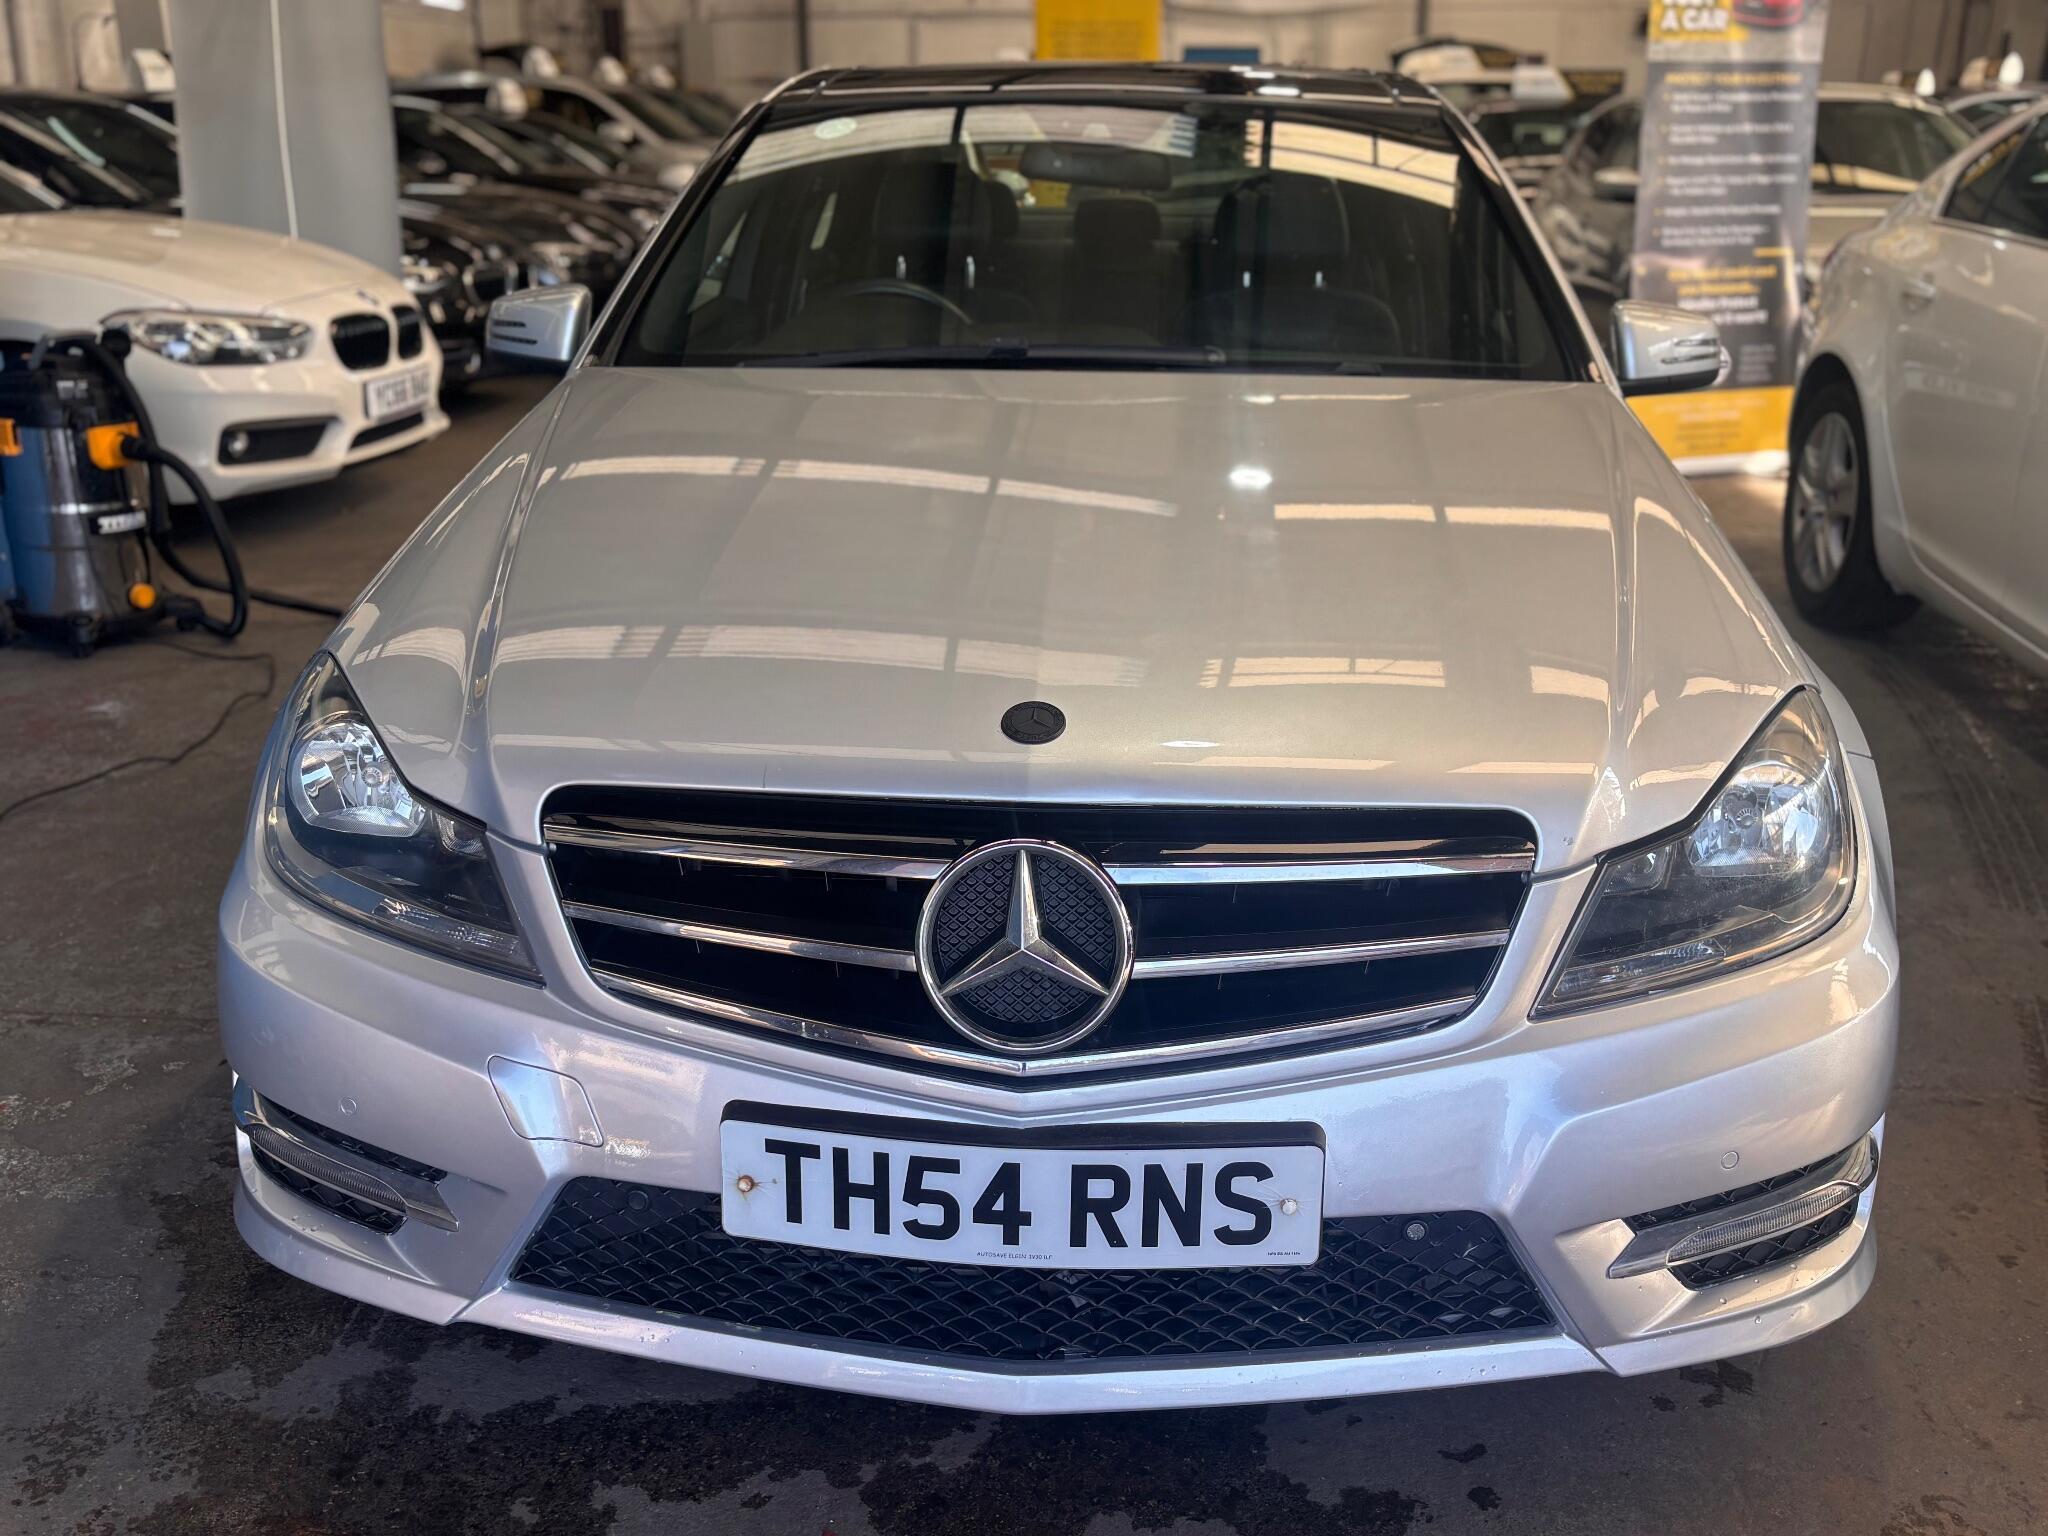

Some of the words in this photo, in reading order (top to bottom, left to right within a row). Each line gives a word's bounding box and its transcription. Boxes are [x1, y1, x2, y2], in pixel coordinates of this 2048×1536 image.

[1659, 8, 1679, 32] A
[1682, 8, 1729, 32] CAR
[765, 1138, 1032, 1246] TH54
[1070, 1161, 1274, 1248] RNS
[976, 1251, 1008, 1259] AUTOSAVE
